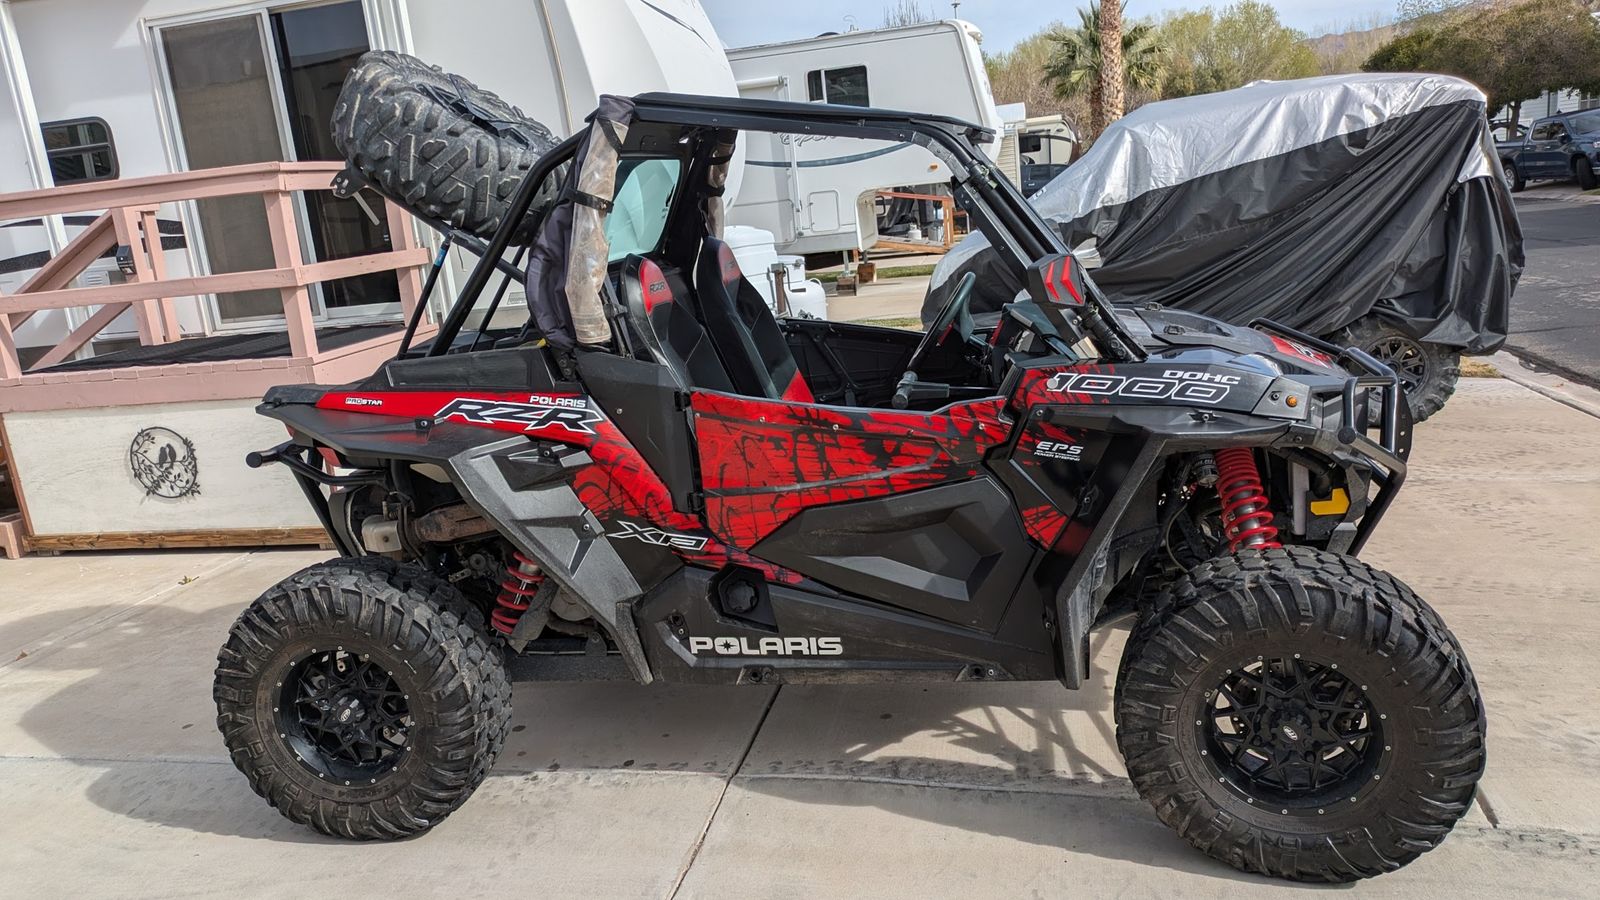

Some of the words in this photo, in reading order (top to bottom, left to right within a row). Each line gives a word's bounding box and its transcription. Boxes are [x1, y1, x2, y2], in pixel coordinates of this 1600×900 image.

[1162, 370, 1241, 385] DOHC
[1046, 373, 1230, 404] 1000
[345, 397, 383, 406] PROSTAR
[529, 395, 586, 408] POLARIS
[434, 398, 603, 435] RZR
[1036, 441, 1084, 454] EPS
[689, 637, 843, 655] POLARIS
